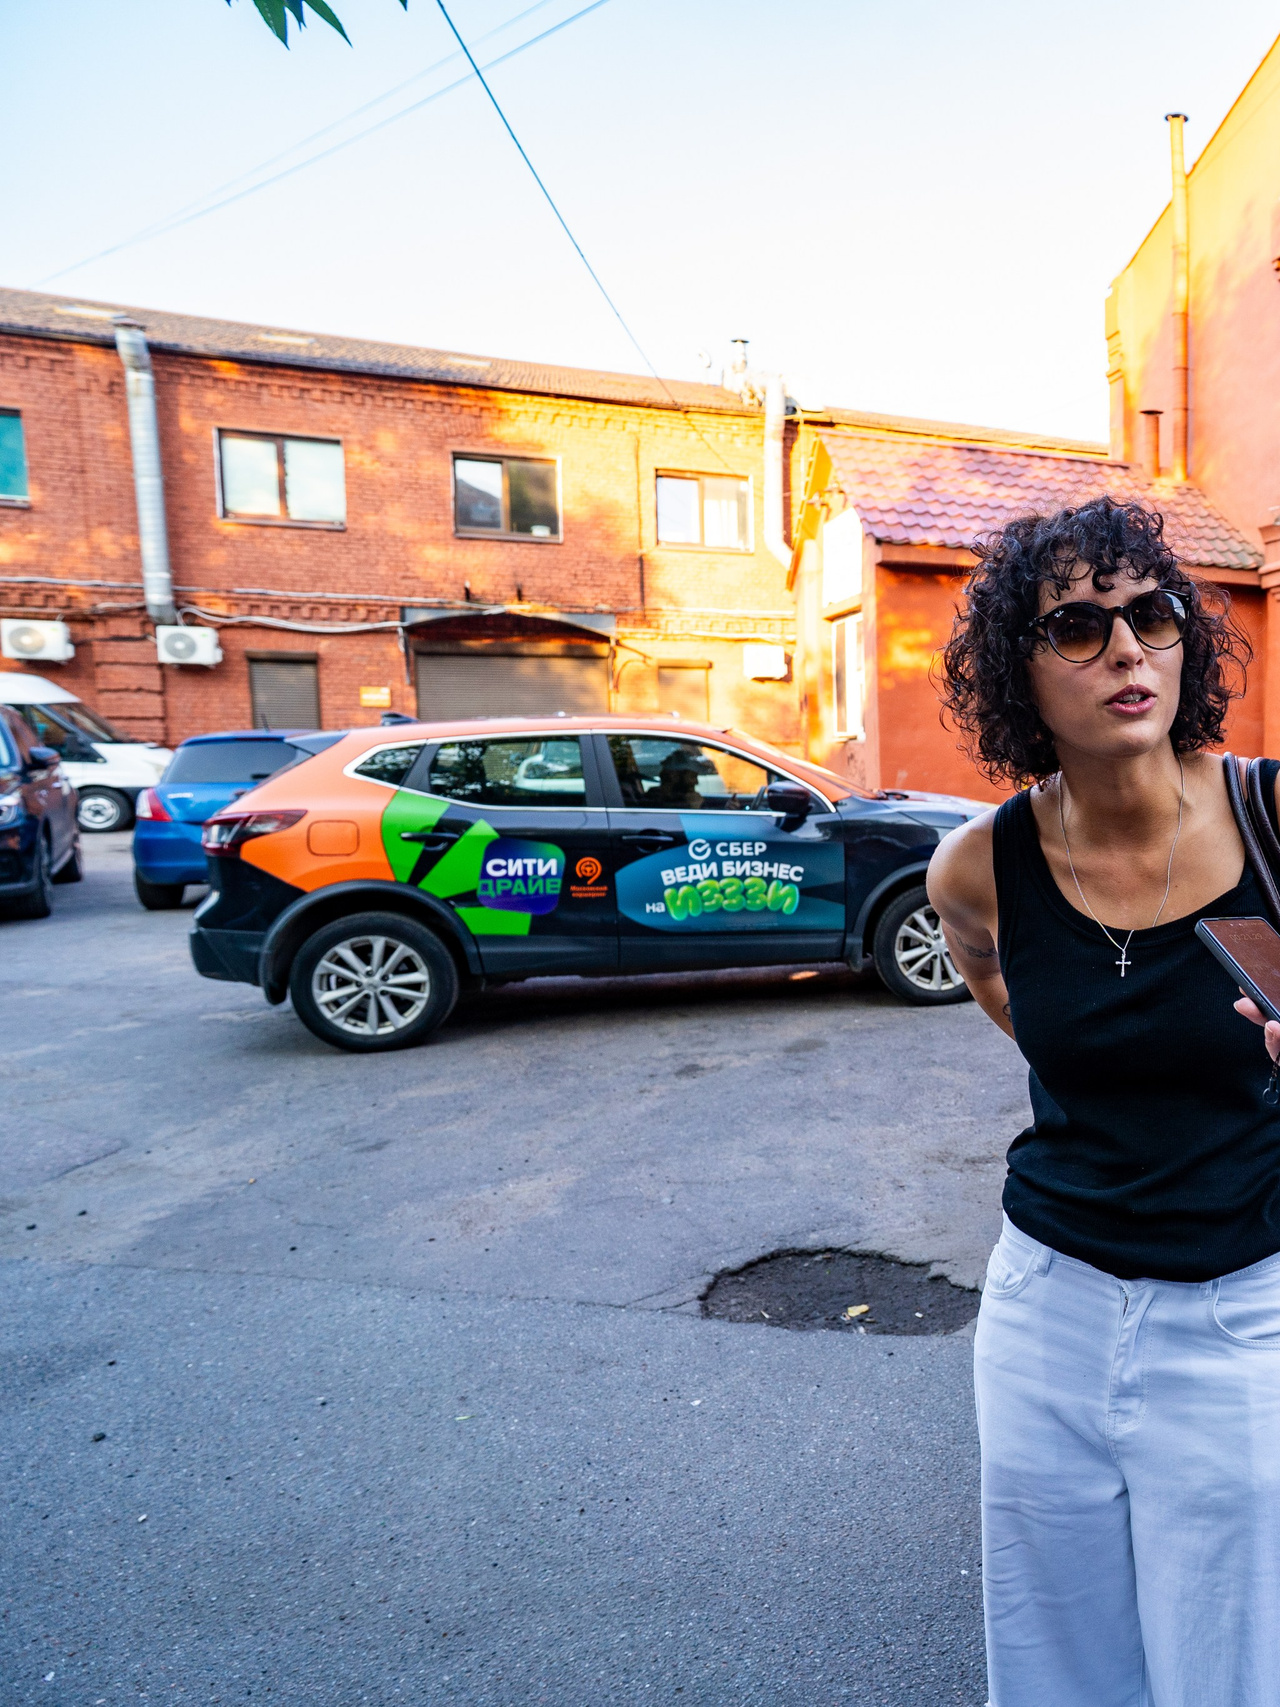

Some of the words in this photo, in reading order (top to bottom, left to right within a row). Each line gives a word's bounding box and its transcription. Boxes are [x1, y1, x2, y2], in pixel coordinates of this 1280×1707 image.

[716, 842, 767, 857] СБЕР
[486, 858, 558, 877] СИТИ
[661, 861, 718, 886] ВЕДИ
[722, 861, 804, 882] БИЗНЕС
[478, 875, 562, 898] ДРАЙВ
[646, 902, 665, 913] на
